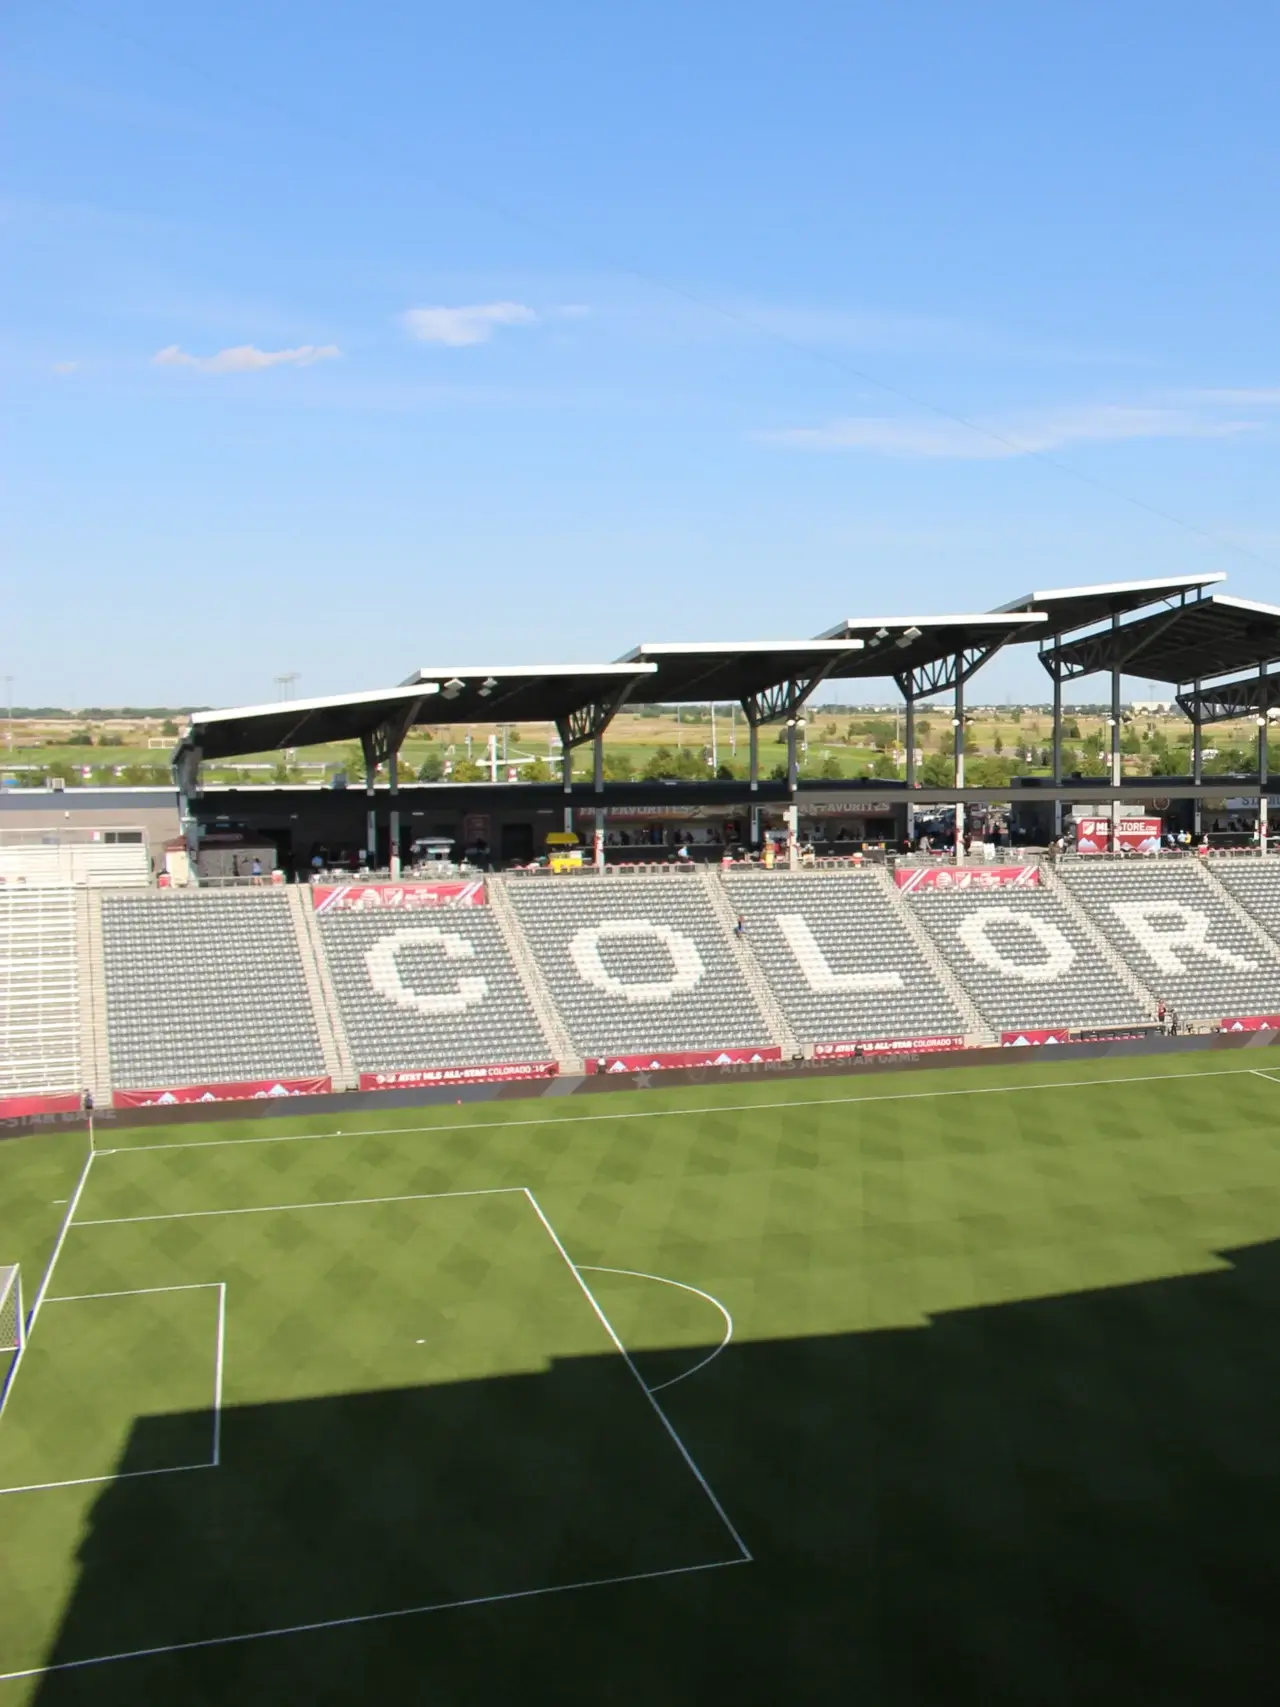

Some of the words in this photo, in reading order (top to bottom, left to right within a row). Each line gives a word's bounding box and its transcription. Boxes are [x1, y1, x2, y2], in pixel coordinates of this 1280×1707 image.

[875, 1040, 912, 1050] ALL-STAR
[913, 1038, 951, 1048] COLORADO
[443, 1068, 487, 1079] ALL-STAR
[488, 1065, 532, 1076] COLORADO
